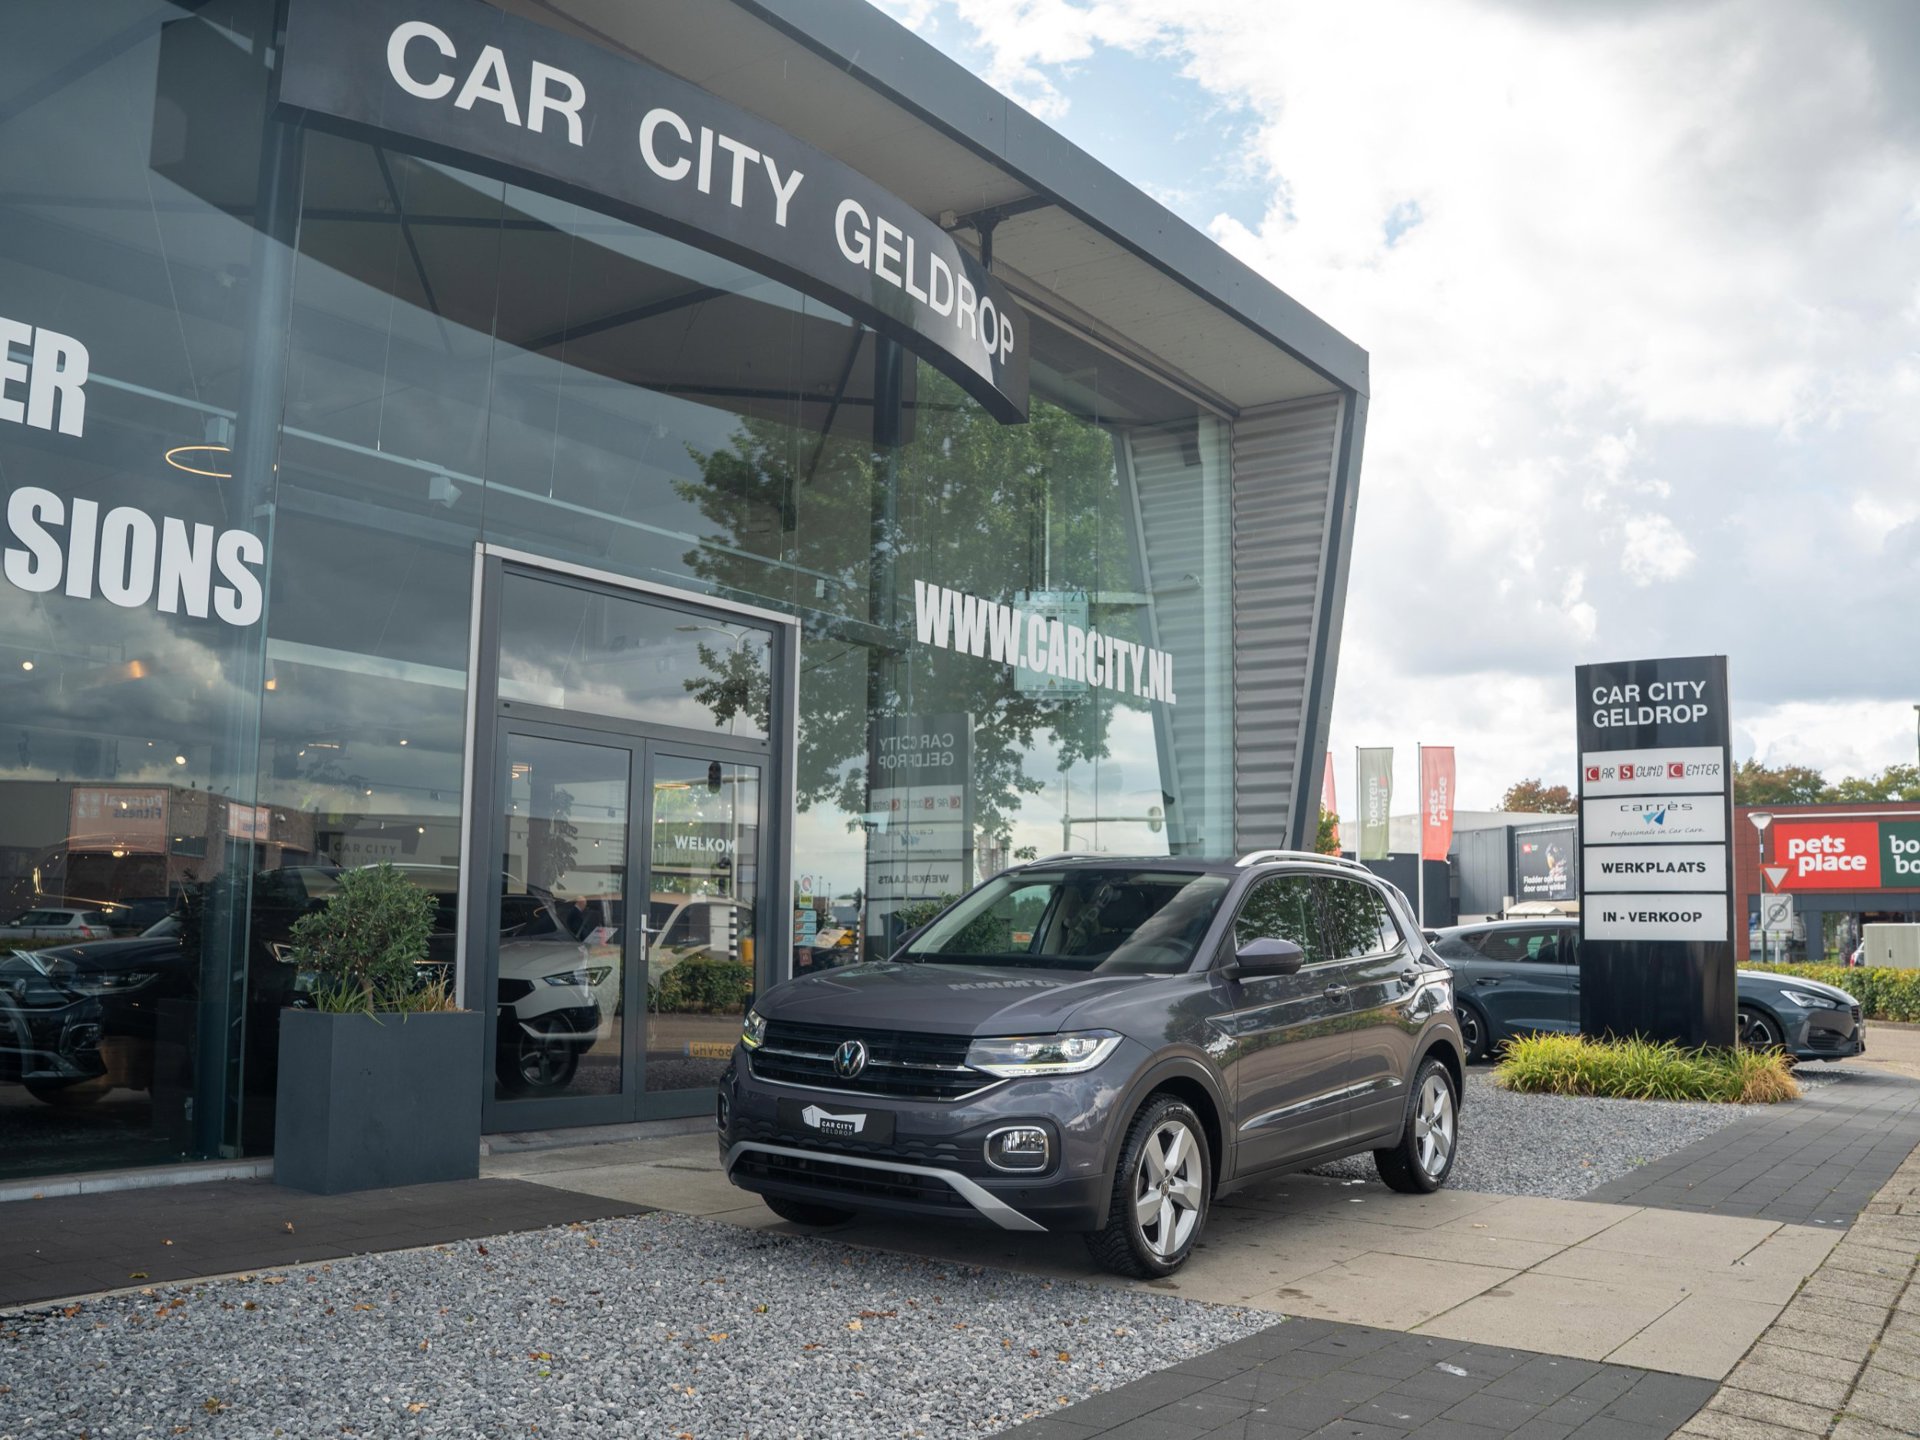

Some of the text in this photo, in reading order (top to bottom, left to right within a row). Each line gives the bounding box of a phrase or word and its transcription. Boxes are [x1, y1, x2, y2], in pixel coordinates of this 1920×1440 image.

[387, 21, 1015, 365] CAR CITY GELDROP
[0, 317, 89, 438] ER
[4, 486, 264, 627] SIONS
[914, 579, 1177, 705] WWW.CARCITY.NL
[1592, 681, 1706, 705] CAR CITY
[1593, 704, 1708, 728] GELDROP
[1586, 763, 1720, 781] CAR SOUND CENTER
[1367, 777, 1379, 828] boeren
[1429, 788, 1441, 827] pets
[1439, 776, 1449, 822] place
[674, 835, 737, 854] WELKOM
[1788, 835, 1846, 859] pets
[1601, 862, 1706, 874] WERKPLAATS
[1798, 853, 1867, 877] place
[1603, 912, 1617, 922] IN
[1628, 911, 1703, 923] VERKOOP
[821, 1120, 853, 1131] CAR CITY
